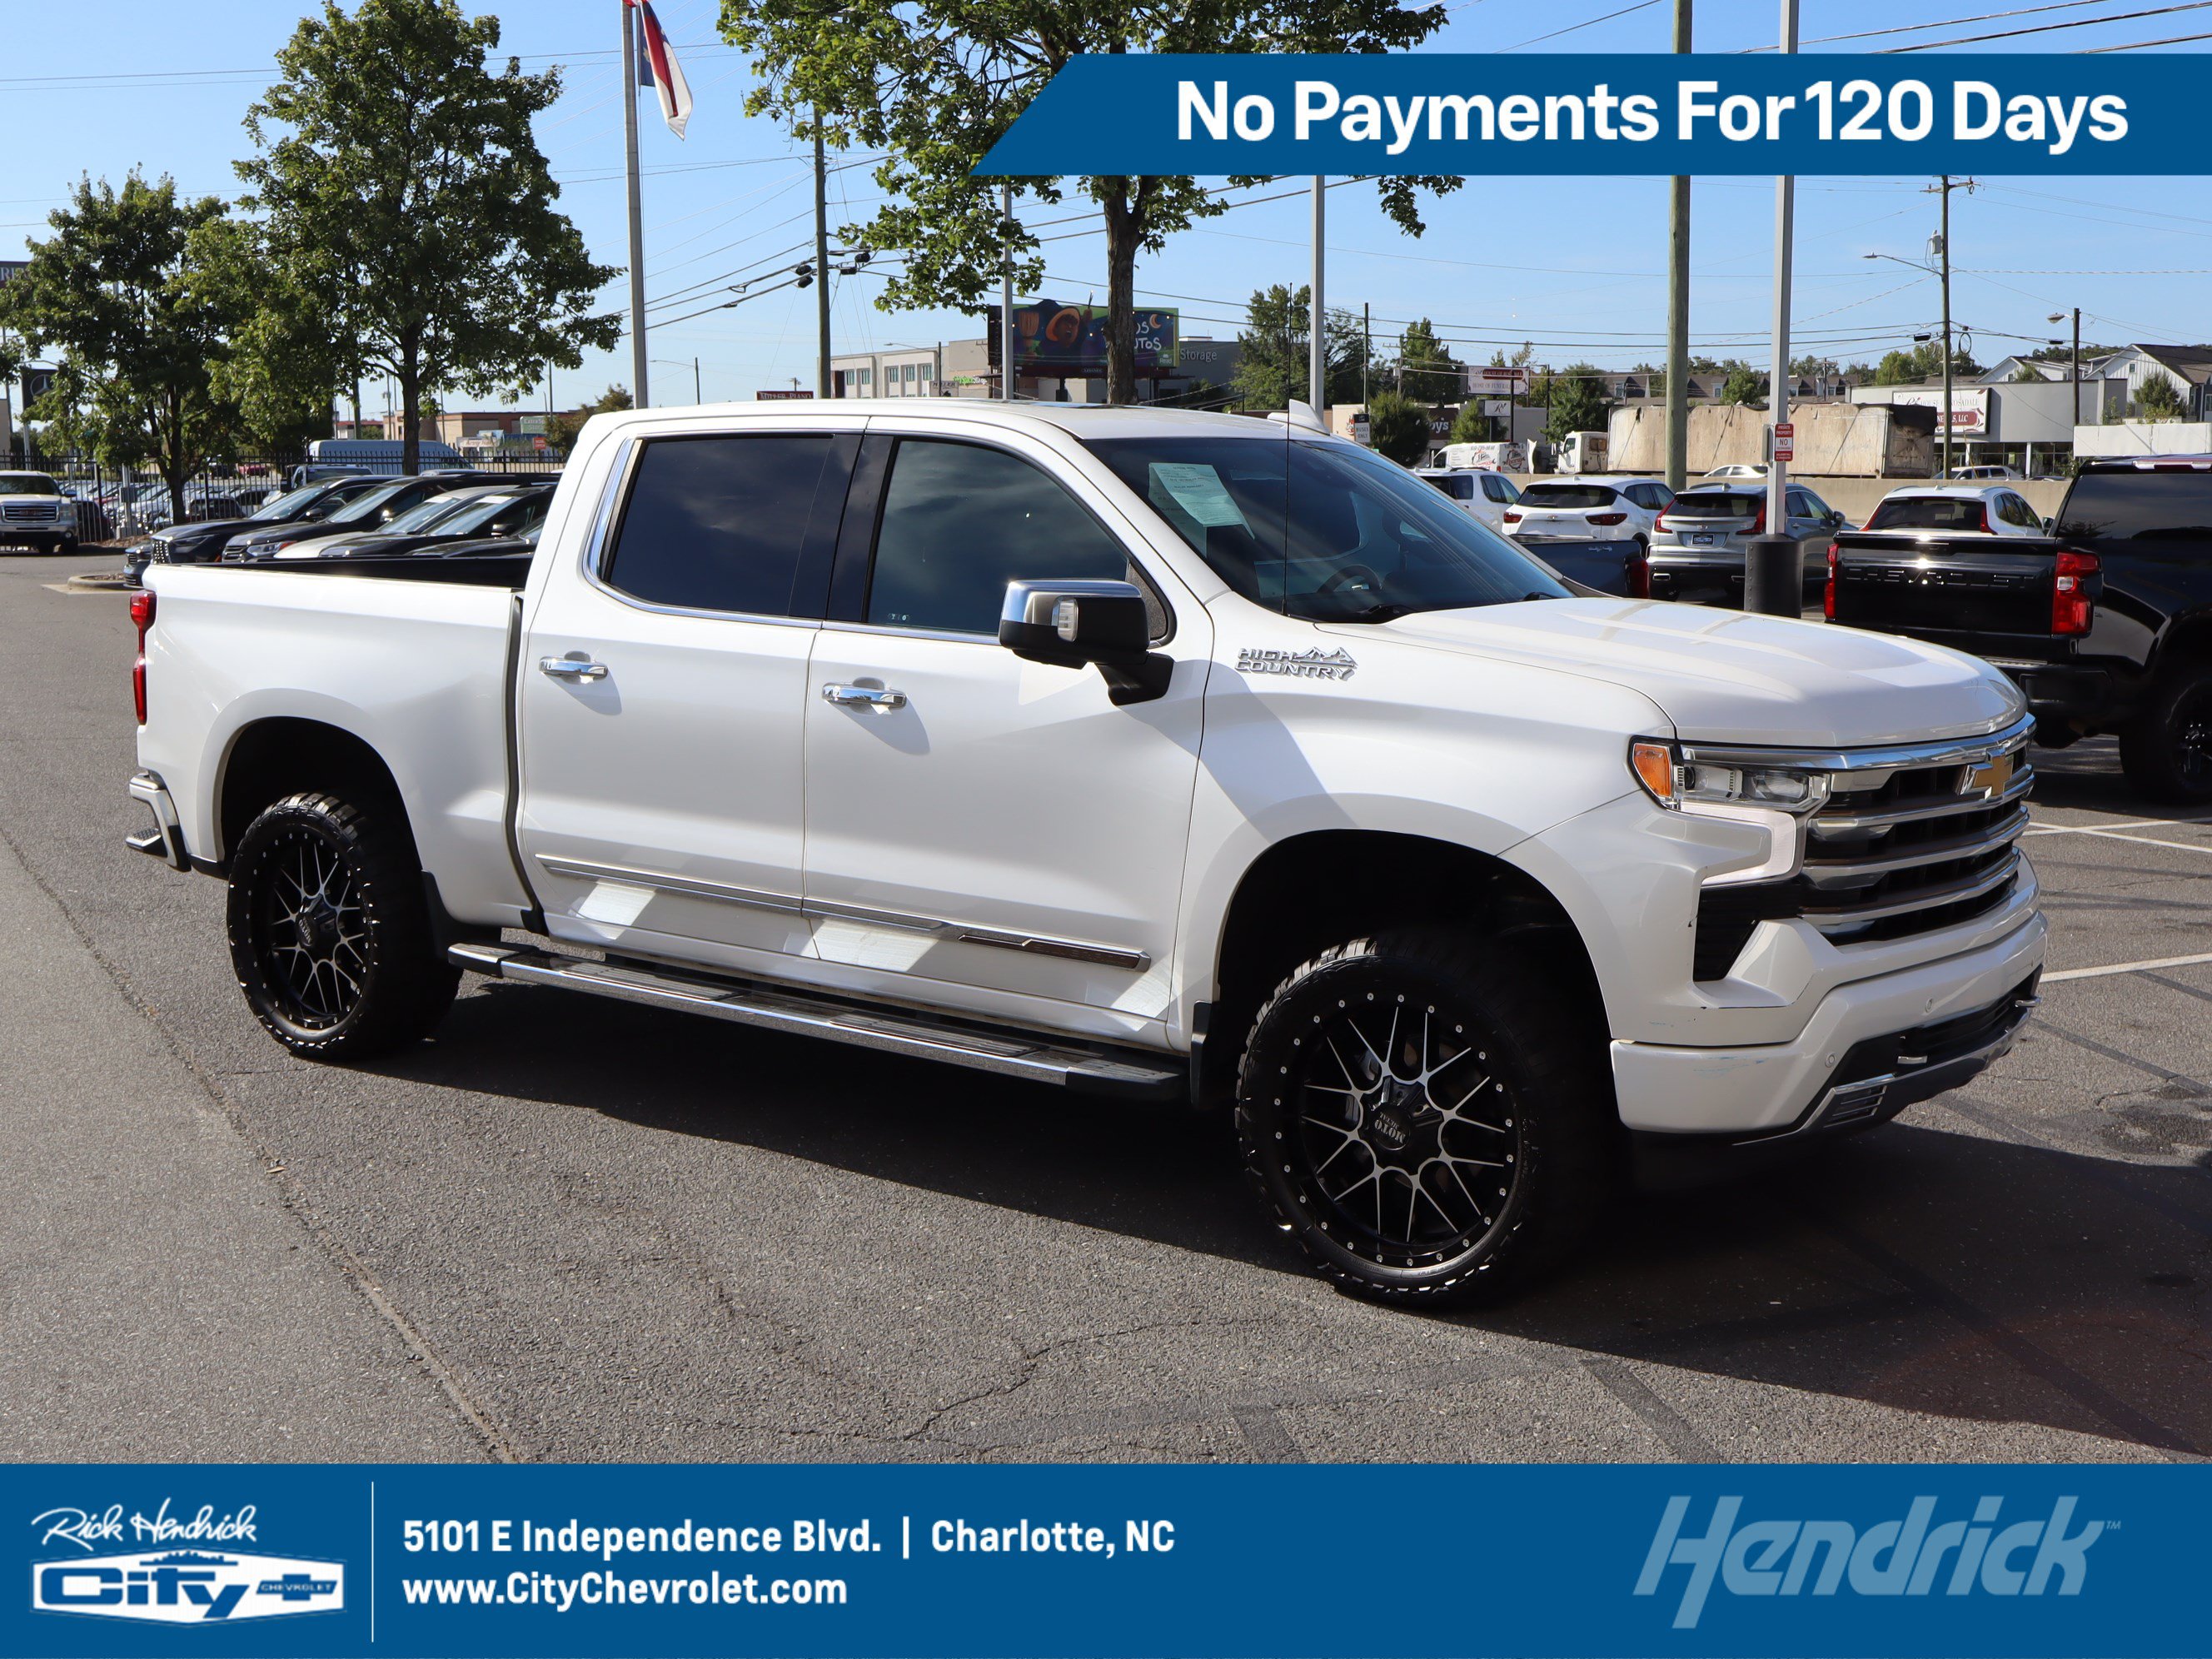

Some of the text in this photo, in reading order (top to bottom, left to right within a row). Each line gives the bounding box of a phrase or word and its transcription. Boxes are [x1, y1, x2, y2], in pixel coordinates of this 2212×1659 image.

[1180, 349, 1218, 362] Storage
[1779, 438, 1789, 446] NO
[1238, 647, 1296, 661] HIGH
[1234, 660, 1355, 681] COUNTRY
[1374, 1119, 1407, 1144] MOTO
